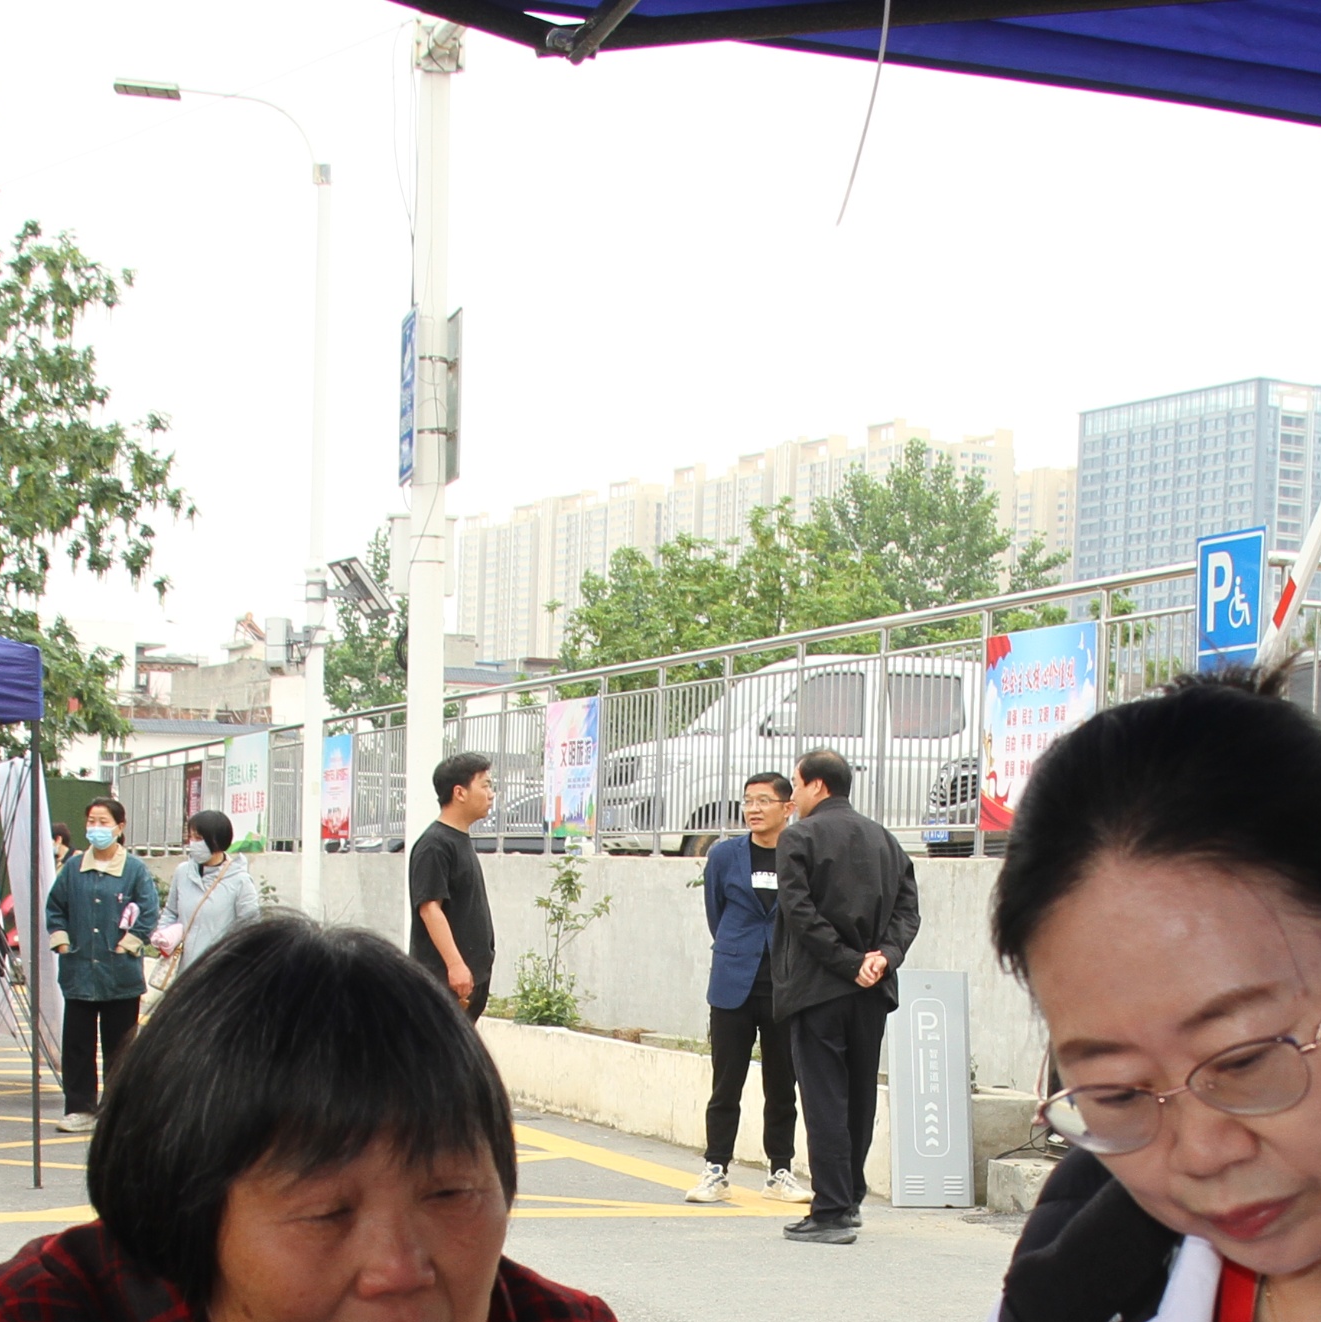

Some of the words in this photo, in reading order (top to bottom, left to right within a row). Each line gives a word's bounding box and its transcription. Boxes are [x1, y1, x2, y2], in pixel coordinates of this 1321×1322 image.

[1206, 551, 1234, 633] P
[1001, 655, 1077, 694] 社会主义核心价值观
[1022, 707, 1033, 726] 民主
[1038, 706, 1050, 723] 文明
[560, 739, 592, 767] 文明旅游
[1021, 734, 1032, 752] 平等
[917, 1011, 939, 1040] P
[928, 1048, 941, 1093] 智能道闸
